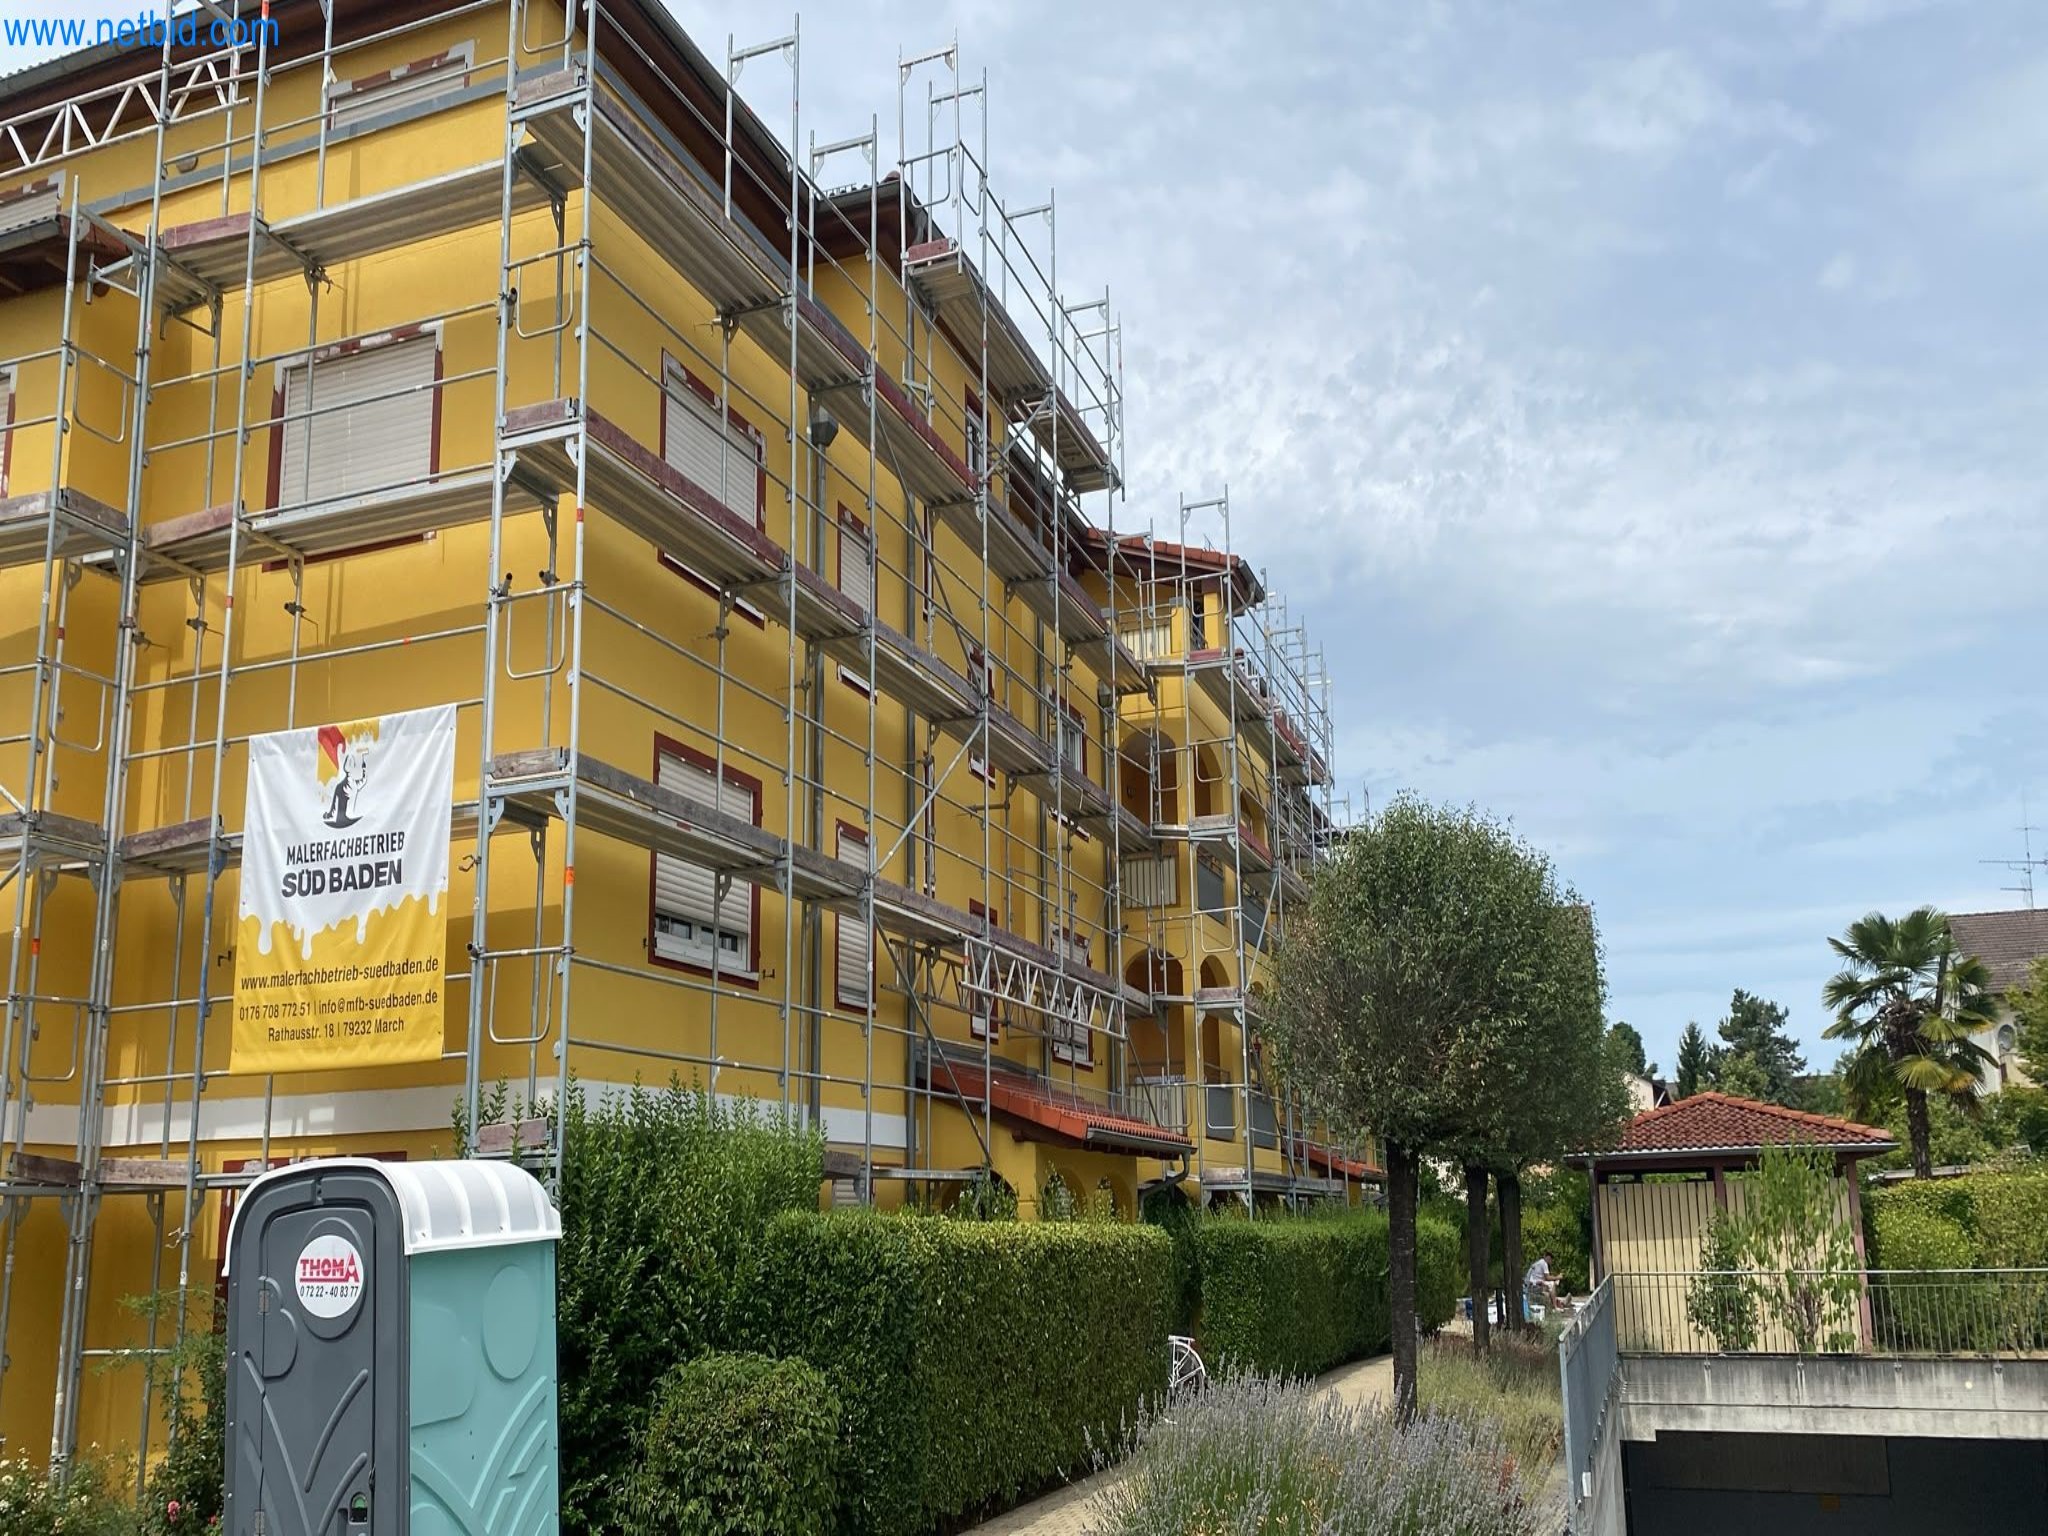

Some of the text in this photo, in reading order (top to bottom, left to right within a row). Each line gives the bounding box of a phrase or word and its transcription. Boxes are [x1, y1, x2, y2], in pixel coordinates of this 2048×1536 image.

[286, 831, 405, 866] MALERFACHBETRIEB
[281, 858, 402, 898] SÜD BADEN
[241, 955, 438, 990] www.malerfachbetrieb-suedbaden.de
[239, 1006, 260, 1021] 0176
[262, 1004, 279, 1018] 708
[282, 1002, 297, 1018] 772
[299, 1002, 311, 1017] 51
[318, 989, 438, 1015] info@mfb-suedbaden.de
[268, 1024, 321, 1042] Rathausstr.
[325, 1023, 335, 1038] 18
[343, 1020, 372, 1036] 79232
[374, 1017, 404, 1033] March
[300, 1251, 359, 1283] THOMA
[306, 1285, 314, 1297] 72
[315, 1285, 323, 1297] 22
[329, 1285, 338, 1298] 40
[350, 1285, 359, 1297] 77
